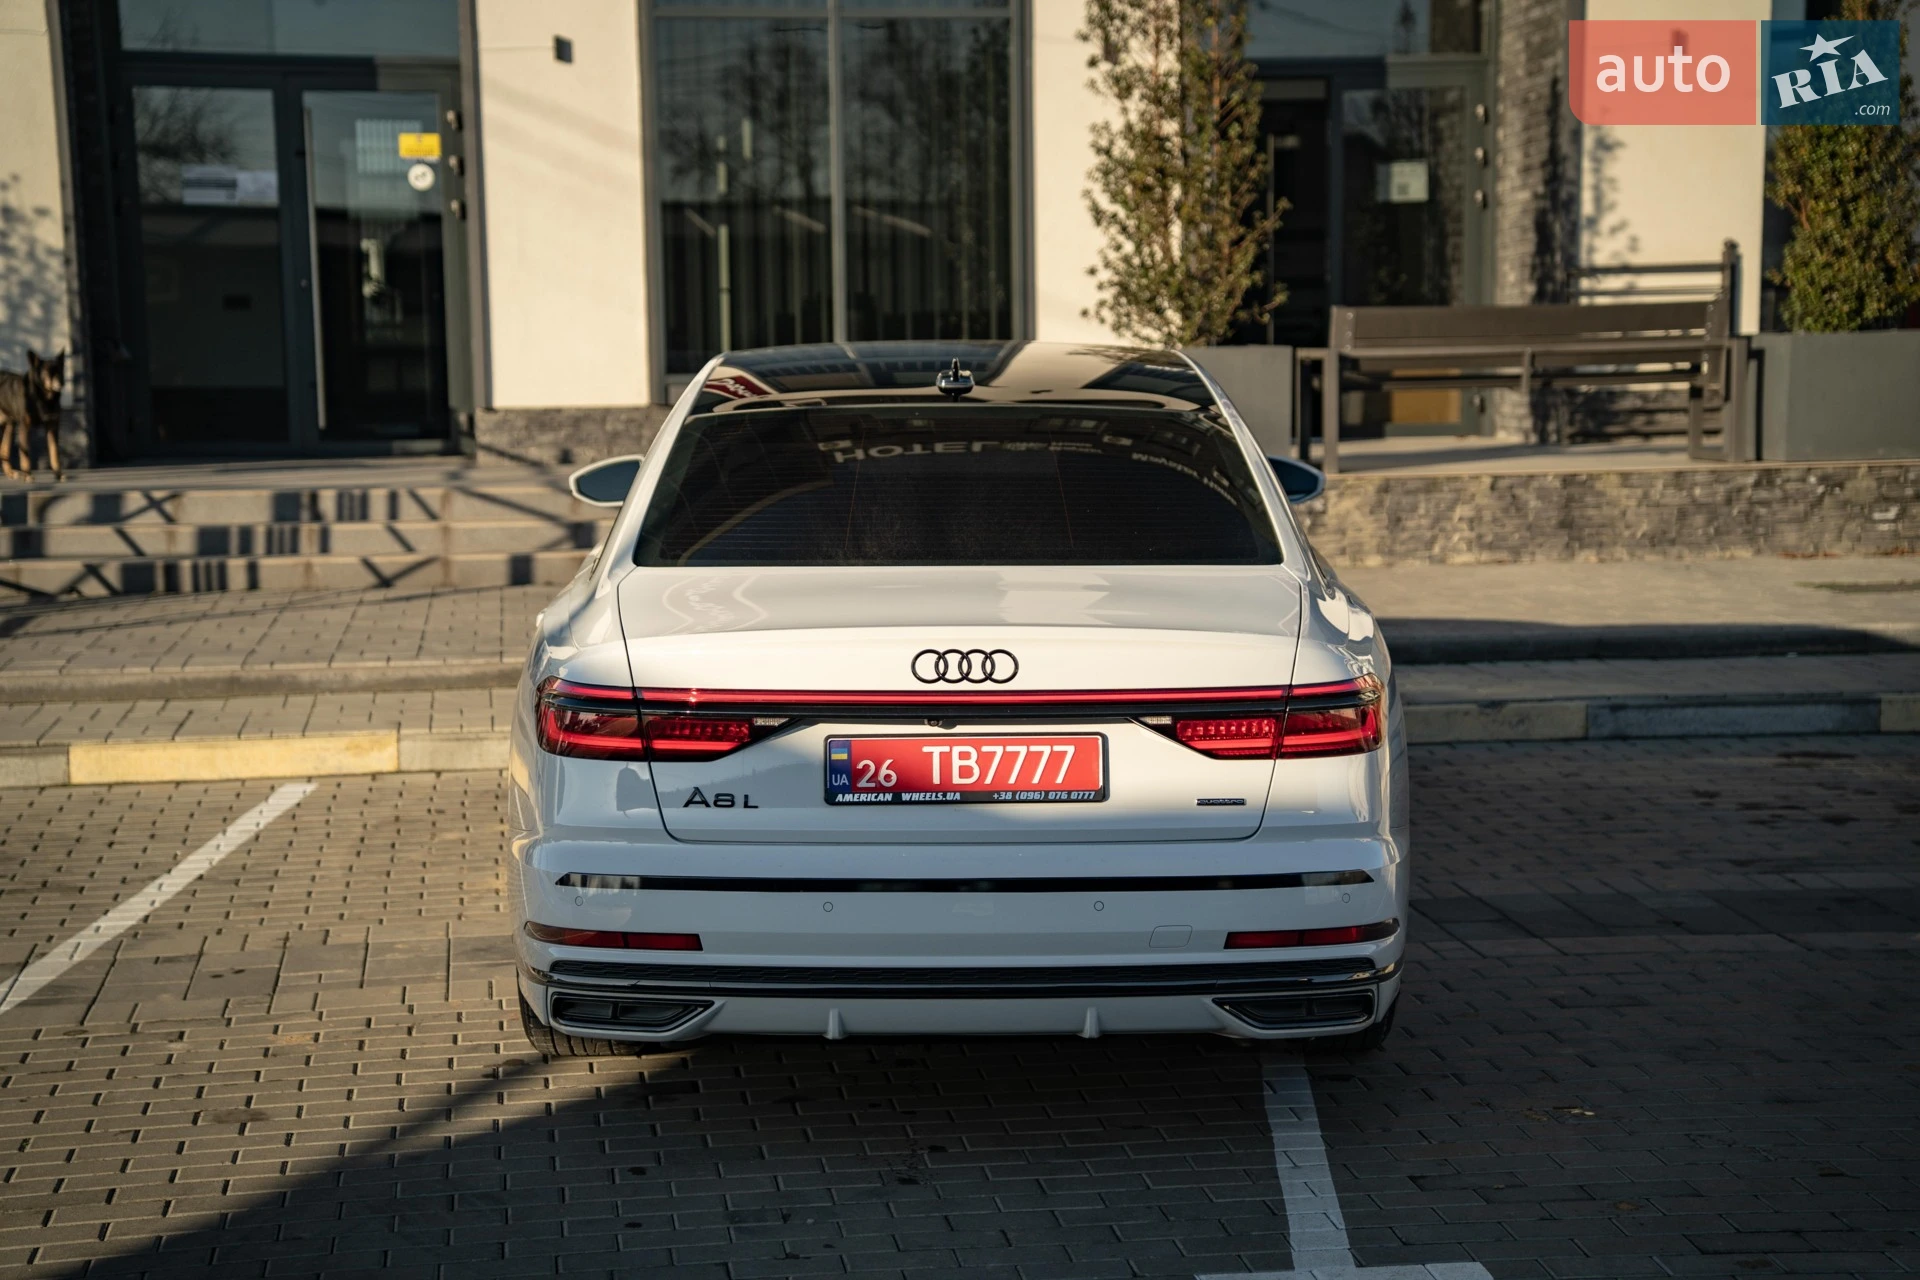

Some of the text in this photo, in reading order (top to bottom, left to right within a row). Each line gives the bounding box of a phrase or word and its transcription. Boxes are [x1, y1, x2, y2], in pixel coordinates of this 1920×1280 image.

[856, 745, 1076, 788] 26 TB7777
[832, 774, 849, 786] UA
[682, 786, 759, 809] A8 L
[835, 791, 1096, 802] AMERICAN WHEELS.UA +38 (096) 076 0777
